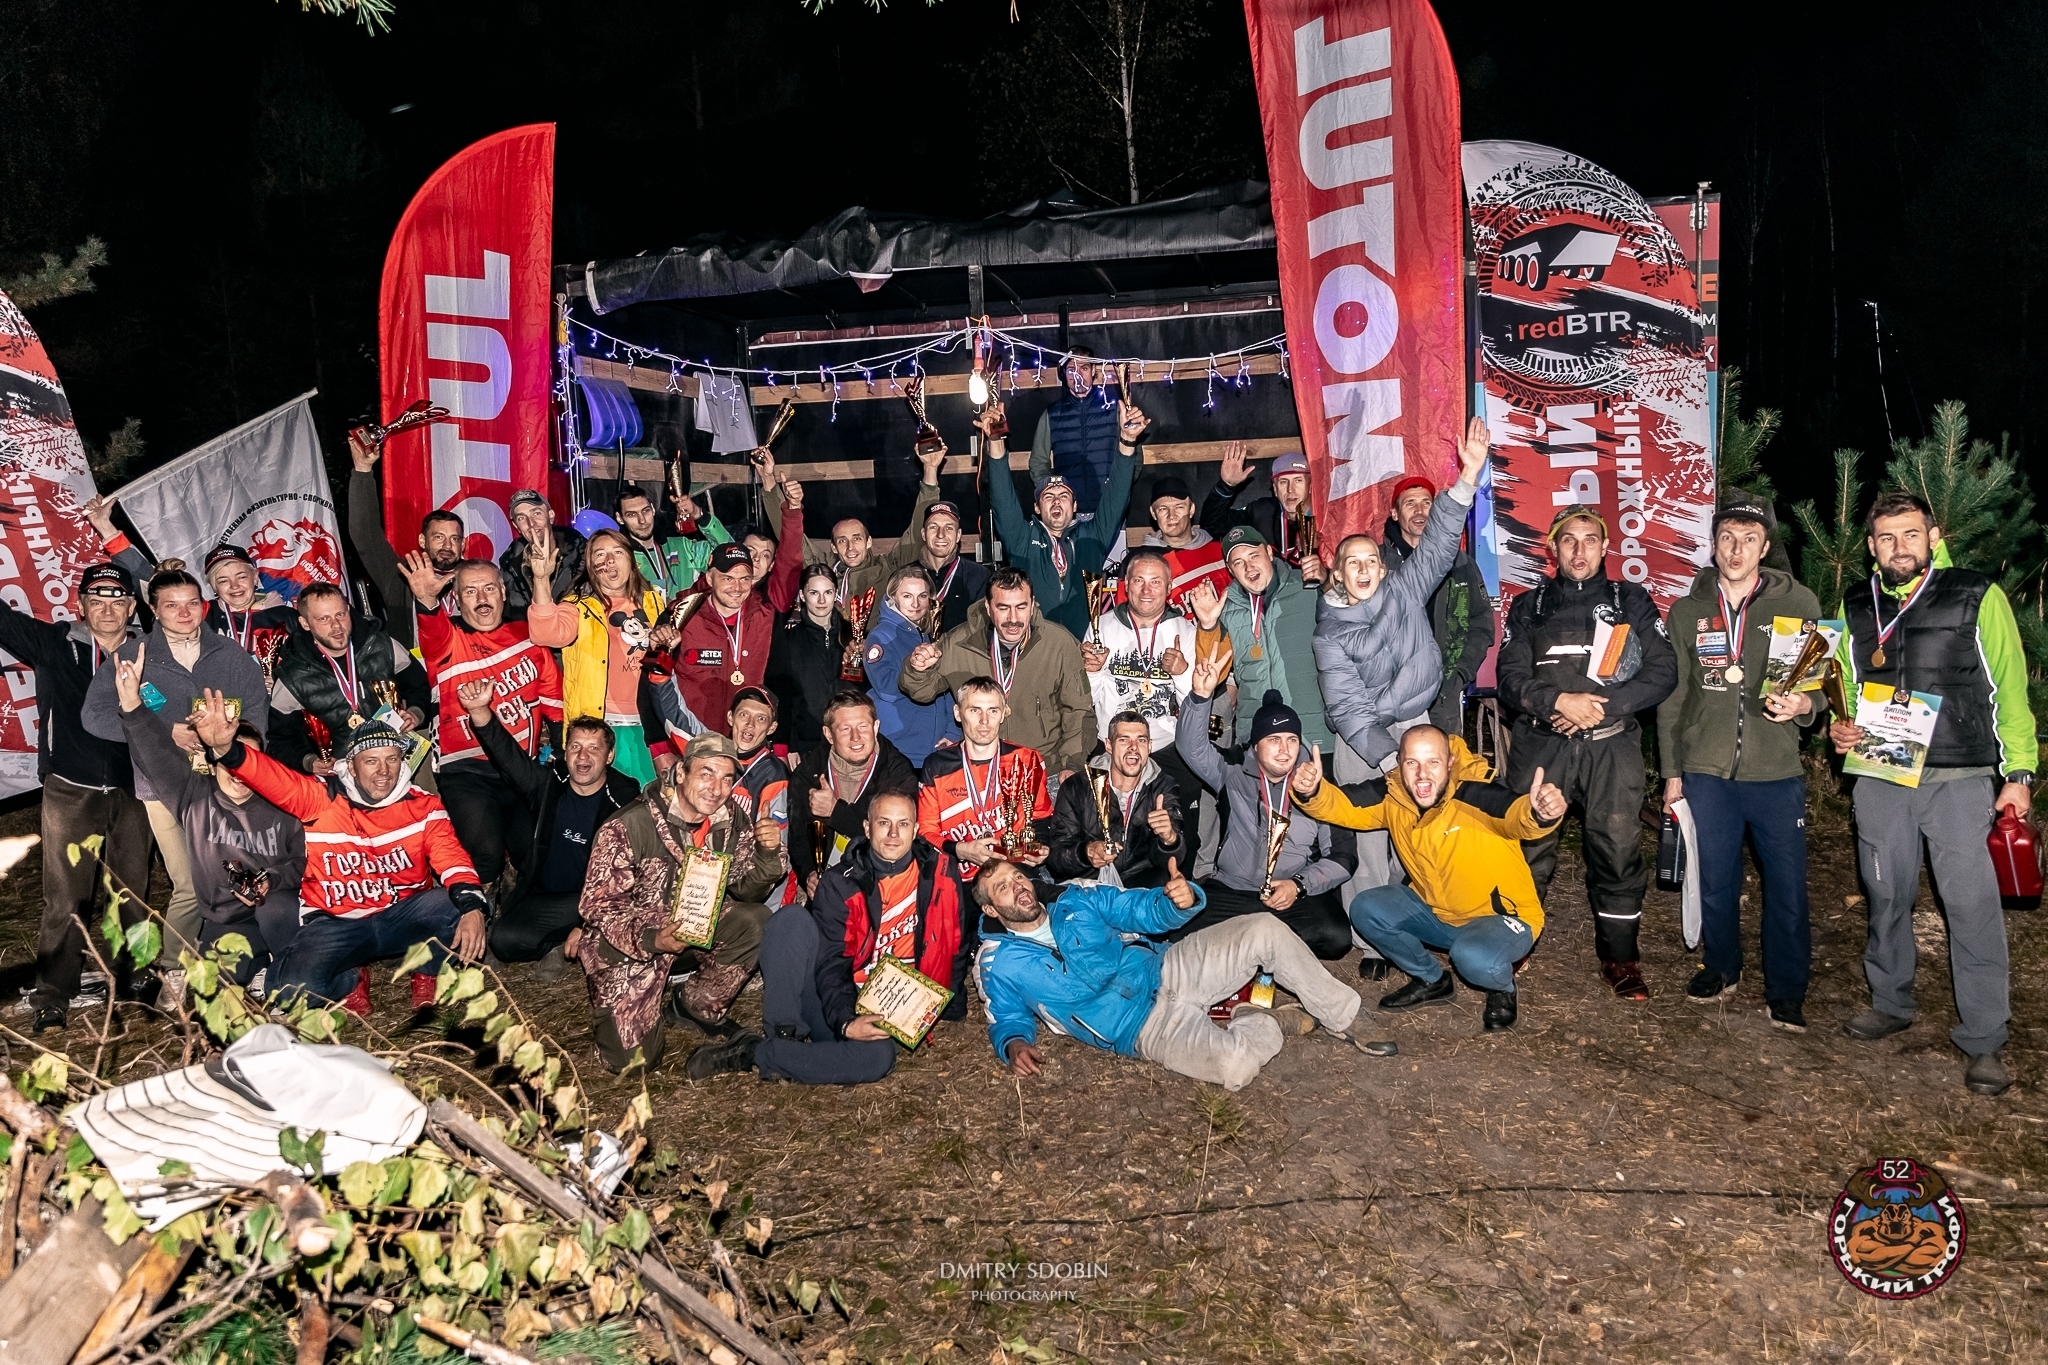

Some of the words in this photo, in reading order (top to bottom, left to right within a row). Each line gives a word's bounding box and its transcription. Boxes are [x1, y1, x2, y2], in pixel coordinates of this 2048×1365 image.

[1518, 310, 1632, 341] redBTR
[424, 249, 513, 567] OTUL
[1534, 402, 1601, 507] ЫЙ
[1607, 400, 1649, 584] ОРОЖНЫЙ
[218, 512, 248, 545] ЕСТВЕННАЯ
[246, 493, 298, 515] ФИЗКУЛЬТУРНО
[1, 470, 77, 623] РОЖНЫЙ
[315, 556, 339, 580] РОФСО
[700, 650, 722, 658] JETEX
[1113, 669, 1147, 677] КВАДРИ
[456, 695, 531, 740] ТФИ
[1883, 705, 1912, 717] ДИПЛОМ
[1889, 715, 1908, 723] место
